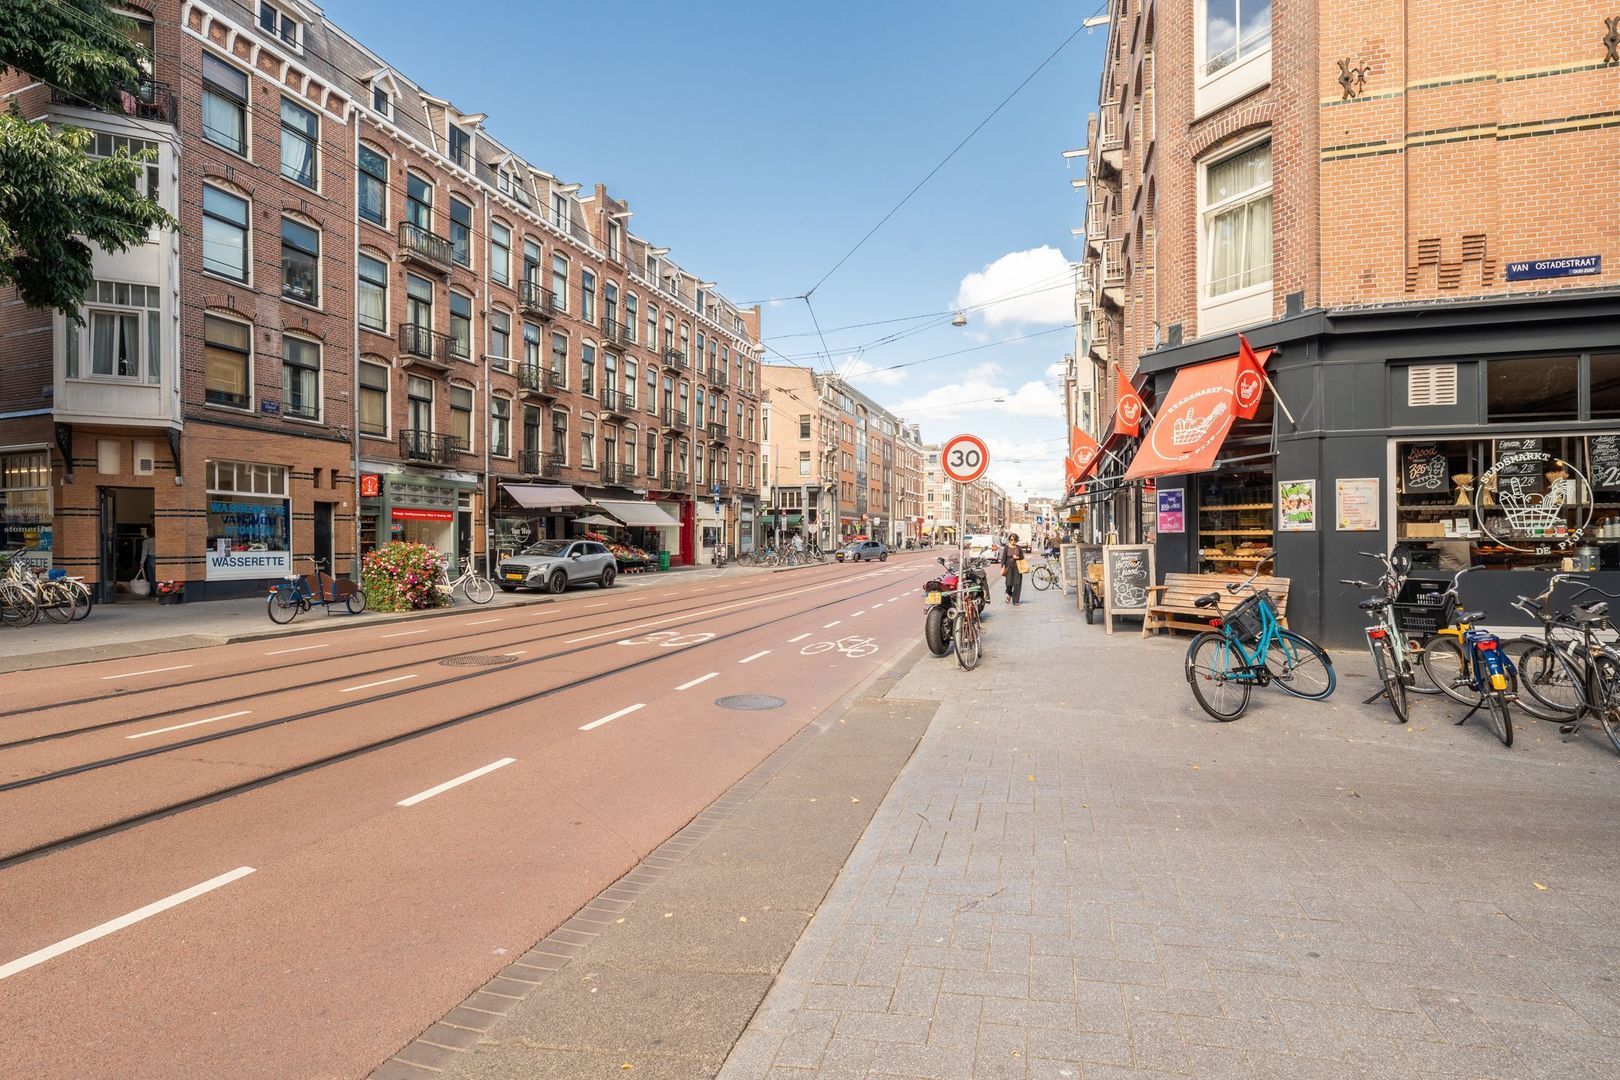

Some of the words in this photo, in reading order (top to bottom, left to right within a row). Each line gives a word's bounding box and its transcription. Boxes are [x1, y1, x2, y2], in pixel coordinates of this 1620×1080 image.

[1511, 263, 1529, 272] VAN
[1535, 258, 1596, 270] OSTADESTRAAT
[950, 449, 981, 468] 30
[1480, 452, 1551, 484] STADSMARKT
[1535, 546, 1551, 556] DE
[1558, 527, 1585, 551] PIJP
[212, 556, 285, 568] WASSERETTE
